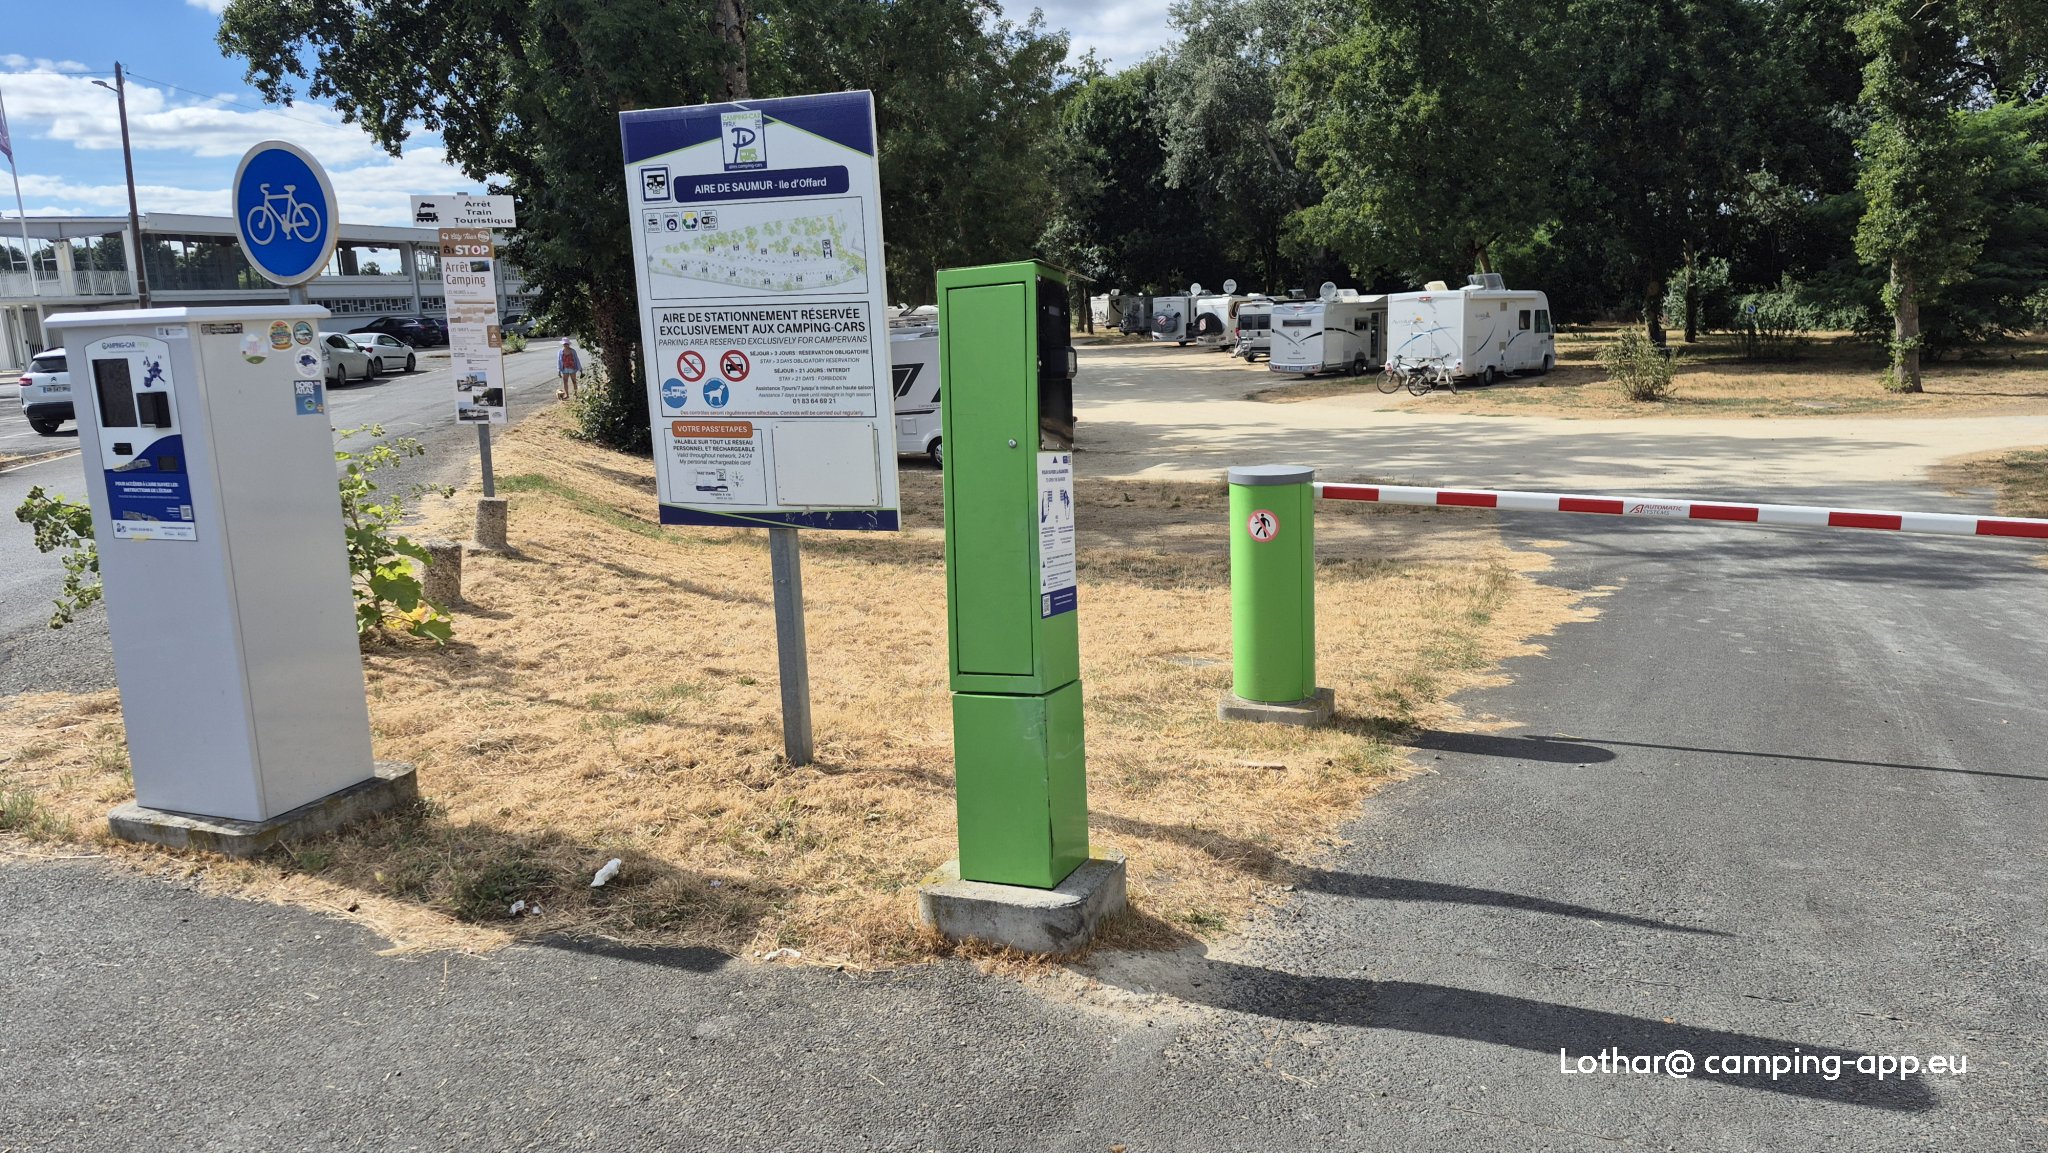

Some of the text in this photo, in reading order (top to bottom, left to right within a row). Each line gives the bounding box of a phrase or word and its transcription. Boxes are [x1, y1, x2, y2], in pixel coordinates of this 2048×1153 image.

[695, 183, 717, 194] AIRE
[717, 182, 731, 193] DE
[732, 180, 773, 192] SAUMUR
[779, 179, 790, 189] Ile
[791, 177, 827, 188] d'Offard
[464, 200, 491, 208] Arrêt
[454, 216, 513, 225] Touristique
[455, 244, 489, 255] STOP
[445, 262, 469, 273] Arrêt
[446, 274, 486, 288] Camping
[662, 306, 861, 323] AIRE DE STATIONNEMENT RÉSERVÉE
[659, 321, 866, 336] EXCLUSIVEMENT AUX CAMPING-CARS
[658, 335, 868, 347] PARKING AREA RESERVED EXCLUSIVELY FOR CAMPERVANS
[296, 387, 314, 395] ATLAS
